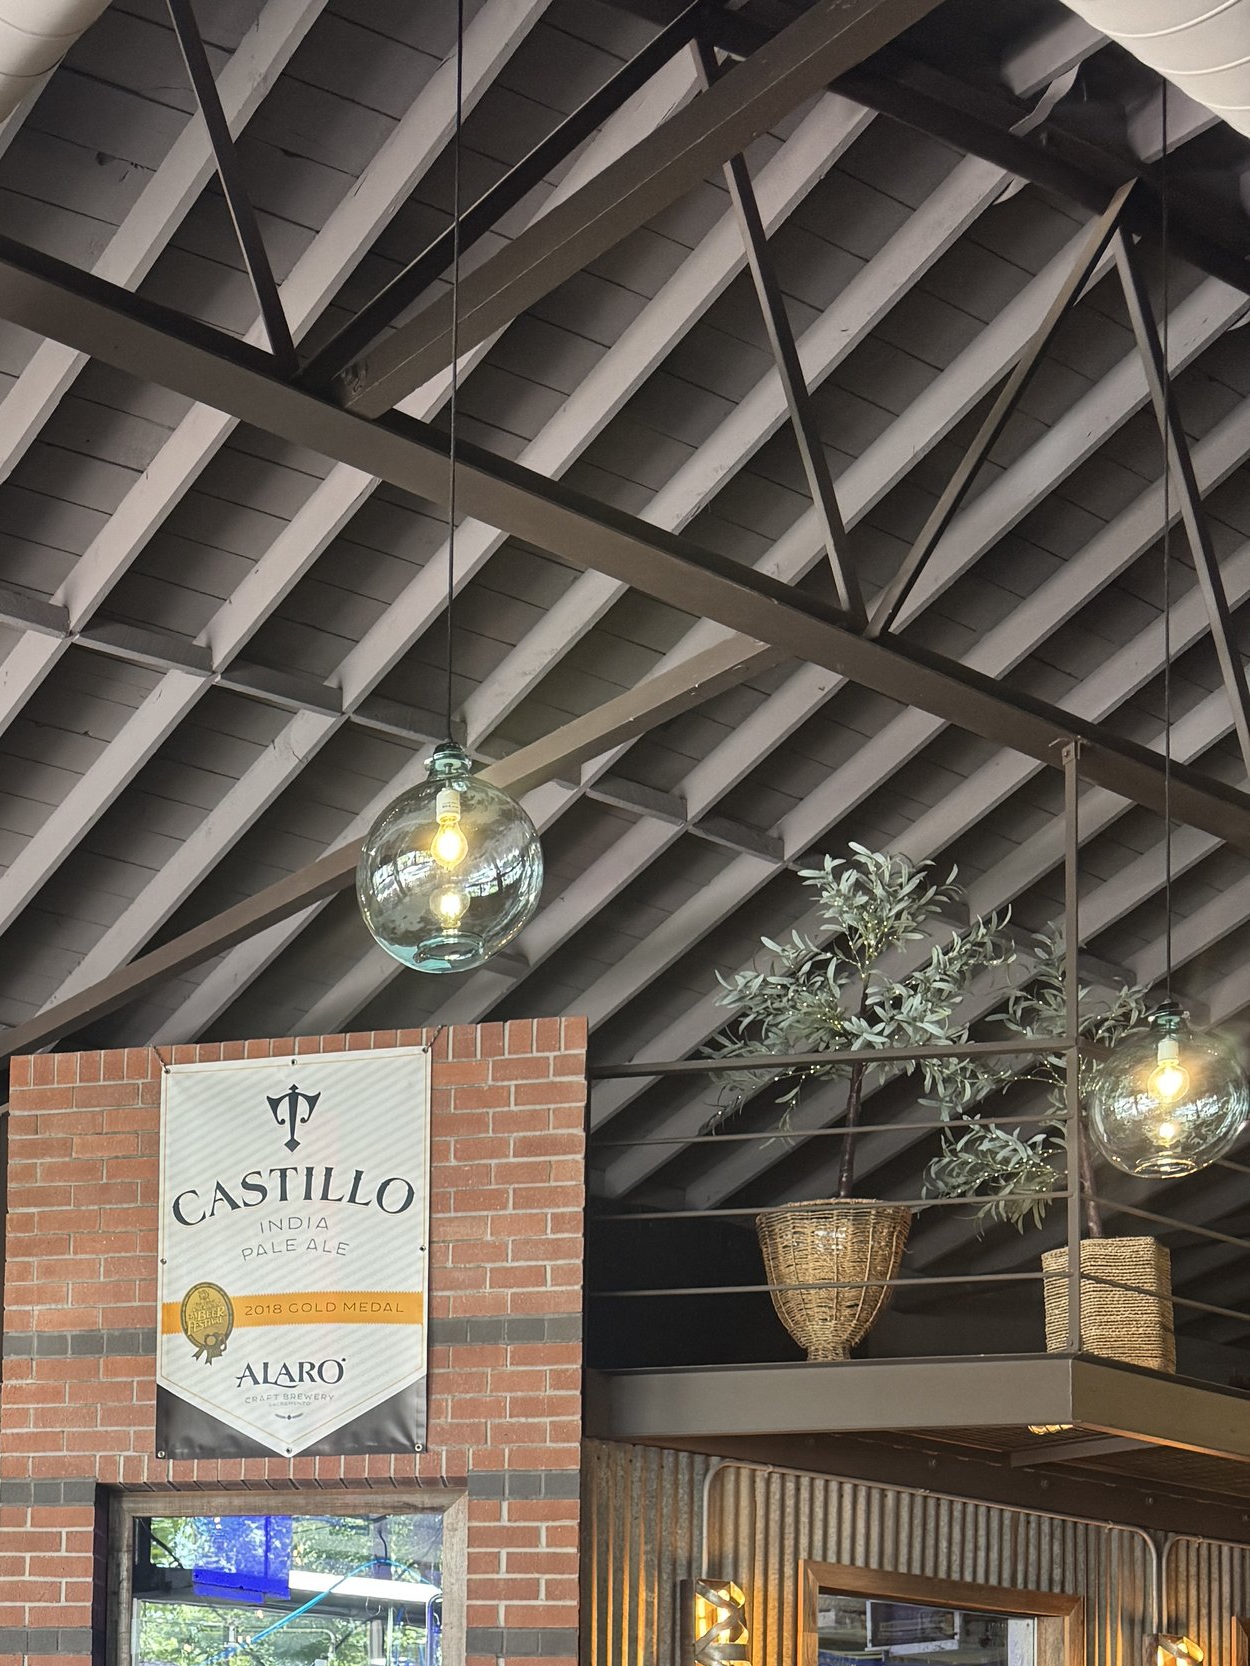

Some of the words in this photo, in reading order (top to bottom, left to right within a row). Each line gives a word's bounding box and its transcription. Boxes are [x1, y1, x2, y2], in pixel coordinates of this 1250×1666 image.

[172, 1166, 415, 1227] CASTILLO
[259, 1216, 329, 1232] INDIA
[241, 1240, 297, 1261] PALE
[307, 1239, 350, 1256] ALE
[245, 1304, 282, 1316] 2018
[288, 1302, 336, 1313] GOLD
[344, 1301, 404, 1313] MEDAL
[245, 1394, 279, 1403] CRAFT
